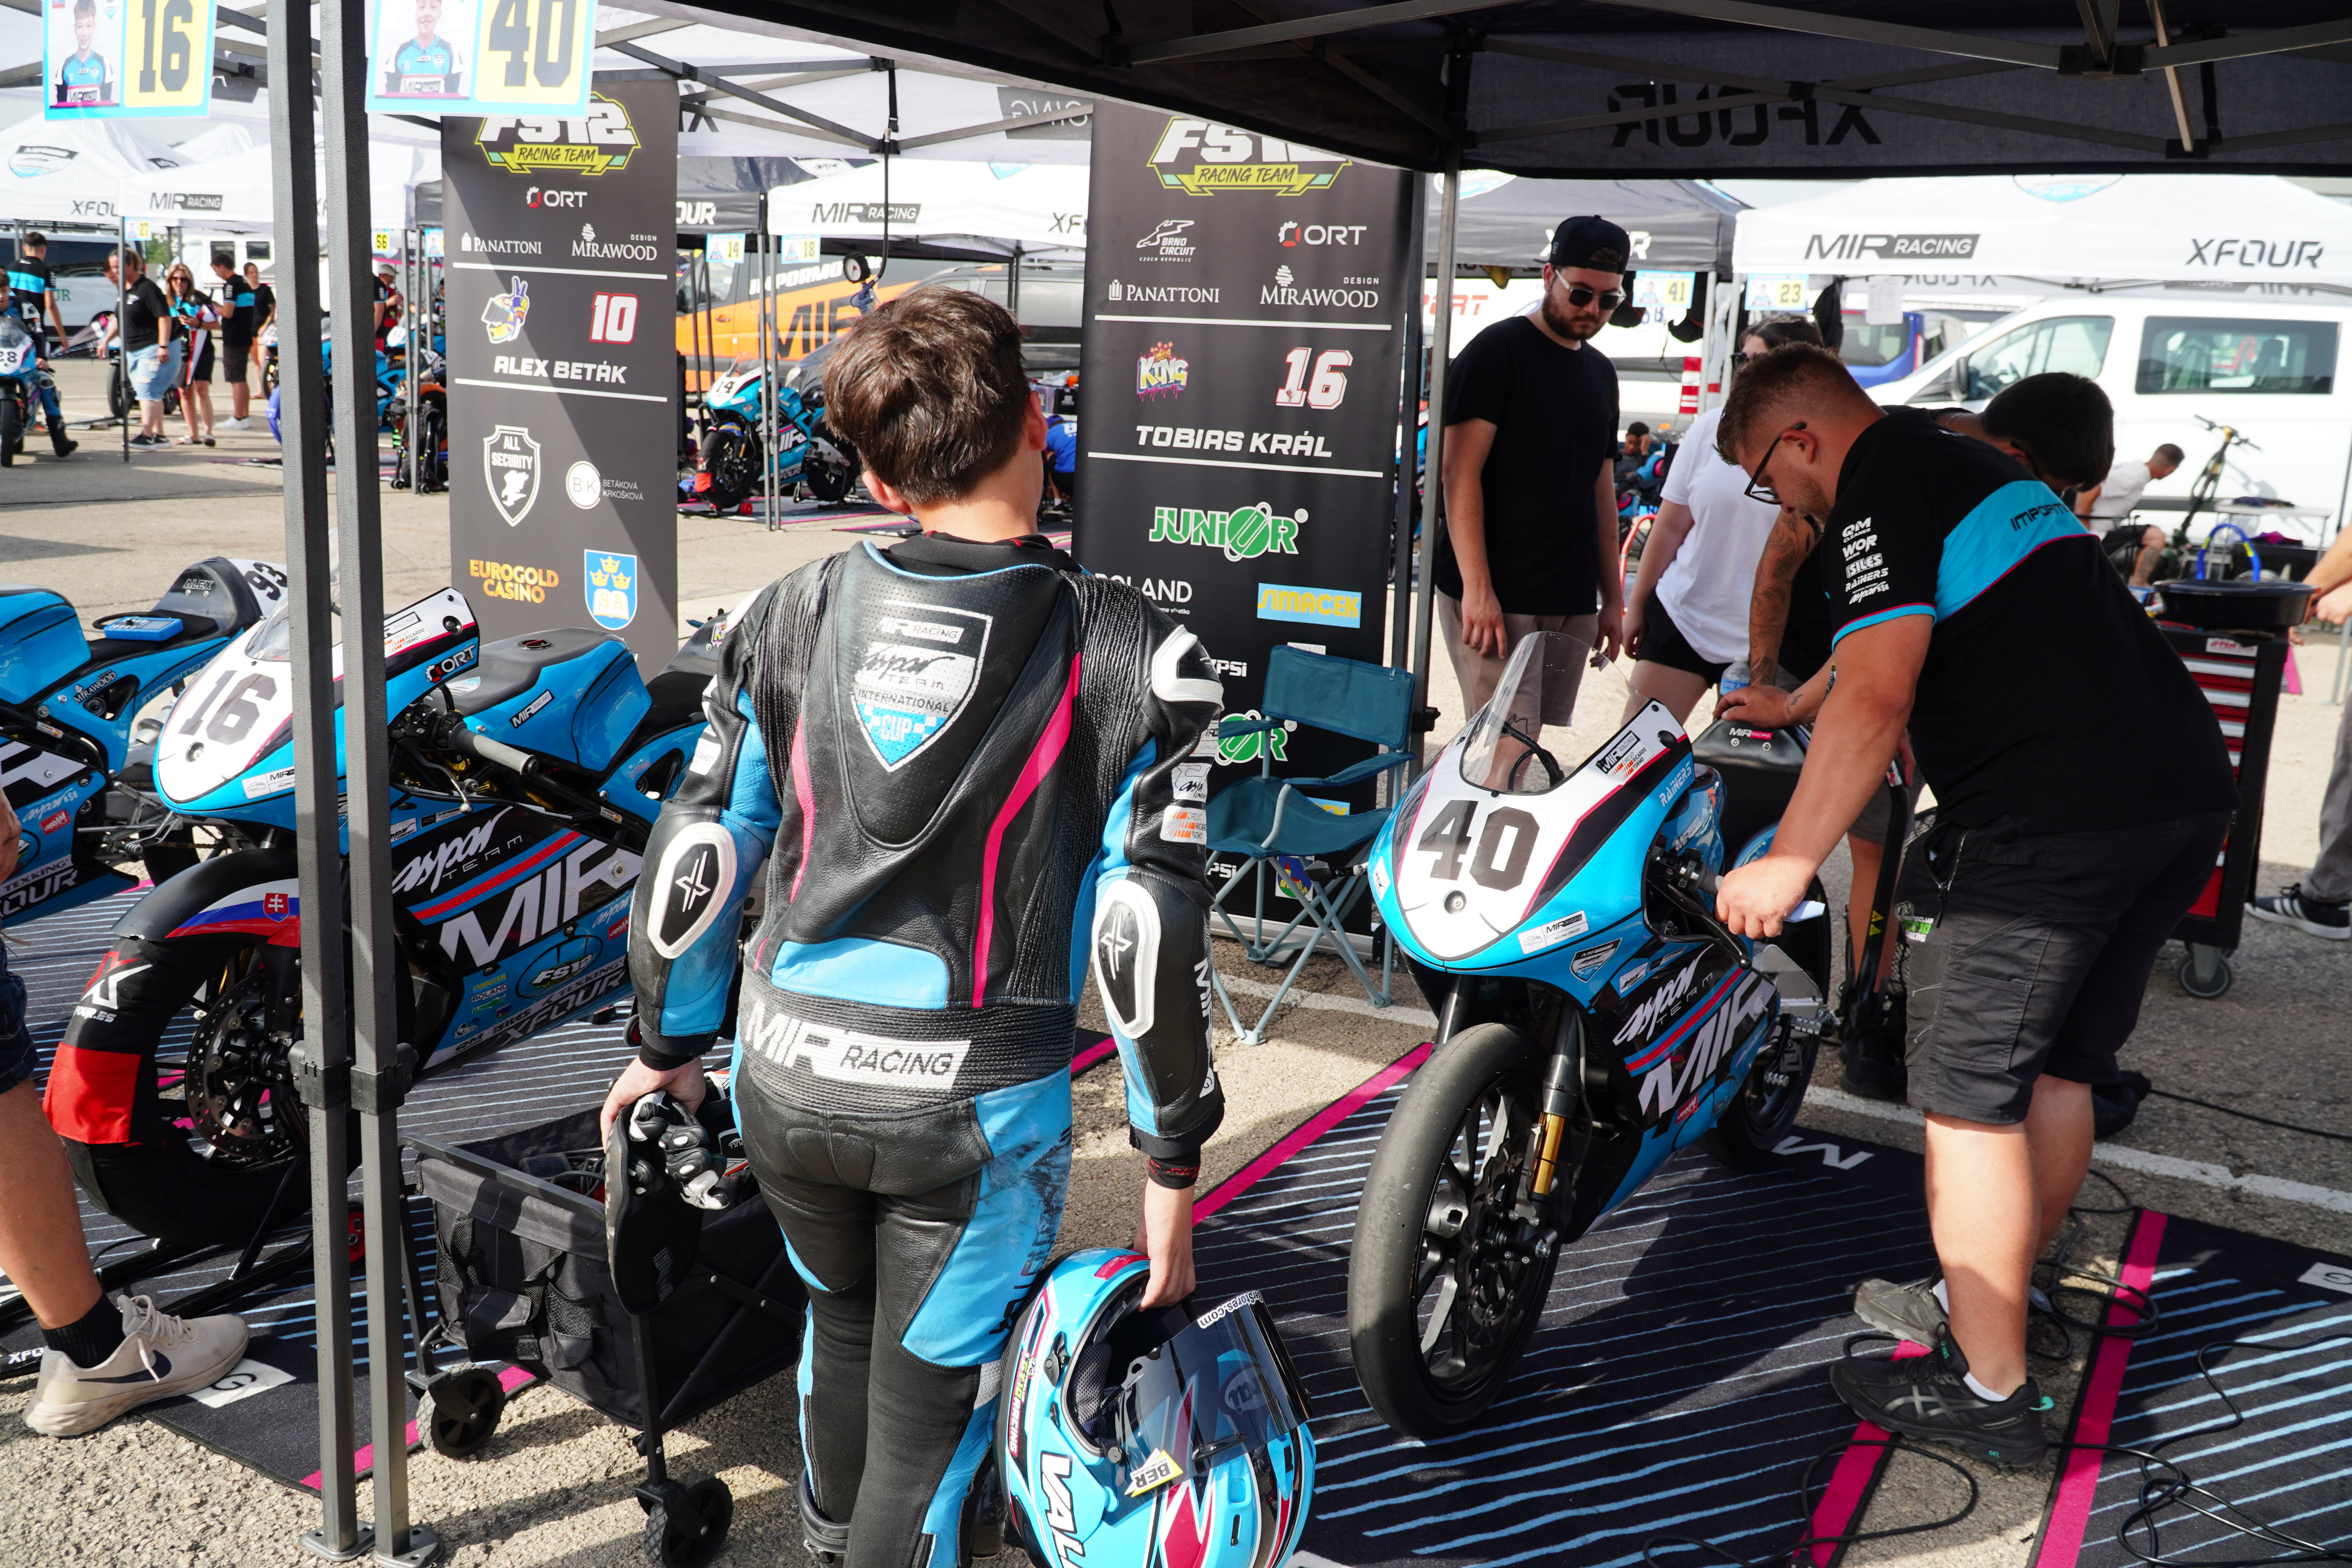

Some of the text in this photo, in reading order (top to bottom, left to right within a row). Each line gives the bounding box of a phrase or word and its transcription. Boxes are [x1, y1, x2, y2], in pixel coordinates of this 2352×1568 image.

[139, 0, 192, 92] 16
[489, 0, 575, 87] 40
[517, 145, 596, 163] RACING TEAM
[1198, 168, 1294, 183] RACING TEAM
[151, 192, 221, 210] MIR RACING
[812, 203, 917, 223] MIR RACING
[377, 235, 387, 249] 56
[474, 239, 542, 255] PANATTONI
[728, 241, 739, 258] 14
[804, 241, 815, 258] 18
[1159, 247, 1196, 256] CIRCUIT
[1162, 238, 1187, 247] BRNO
[1805, 234, 1973, 260] MIR RACING
[2185, 238, 2324, 269] XFOUR
[1126, 284, 1220, 304] PANATTONI
[1668, 281, 1685, 302] 41
[1780, 284, 1801, 303] 23
[590, 292, 639, 344] 10
[494, 356, 628, 384] ALEX BETÁK
[1275, 347, 1353, 410] 16
[503, 436, 521, 451] ALL
[1249, 430, 1332, 457] KRÁL
[492, 452, 533, 470] SECURITY
[603, 478, 638, 490] BETÁKOVÁ
[603, 488, 644, 501] KRKOŠKOVÁ
[1843, 517, 1871, 538] QM
[1844, 528, 1871, 543] CLEANER
[1843, 534, 1878, 558] WOR
[470, 559, 559, 588] EUROGOLD
[1849, 555, 1882, 575] SILES
[183, 579, 214, 590] ALEX
[483, 579, 545, 604] CASINO
[394, 614, 416, 630] RACING
[913, 625, 958, 639] RACING
[393, 630, 410, 642] CIRCUIT
[403, 636, 419, 647] TORMO
[405, 628, 425, 640] RICARDO
[178, 670, 277, 745] 16
[512, 690, 551, 728] MIR RACING
[858, 688, 950, 713] INTERNATIONAL
[880, 715, 913, 742] CUP
[1729, 728, 1751, 738] MIR
[1602, 734, 1635, 772] MIR RACING
[1622, 752, 1635, 766] CIRCUIT
[1632, 747, 1647, 763] RICARDO
[1632, 757, 1645, 770] TORMO
[270, 769, 289, 781] MIR
[393, 806, 514, 893] aspar
[1416, 800, 1540, 892] 40
[442, 835, 523, 880] TEAM
[4, 859, 67, 892] TEXKING
[439, 839, 643, 967] MIR
[1546, 915, 1583, 933] MIR RACING
[532, 953, 593, 987] FS12
[558, 960, 621, 997] TEXKING
[472, 984, 508, 1003] ROLAND
[1613, 943, 1714, 1046] aspar
[1656, 973, 1713, 1025] TEAM
[501, 970, 626, 1046] XFOUR
[496, 1008, 531, 1032] SILES
[745, 999, 953, 1076] MIR RACING
[1638, 971, 1776, 1117] MIR
[1009, 1396, 1024, 1456] RACING
[1134, 1462, 1171, 1488] BER
